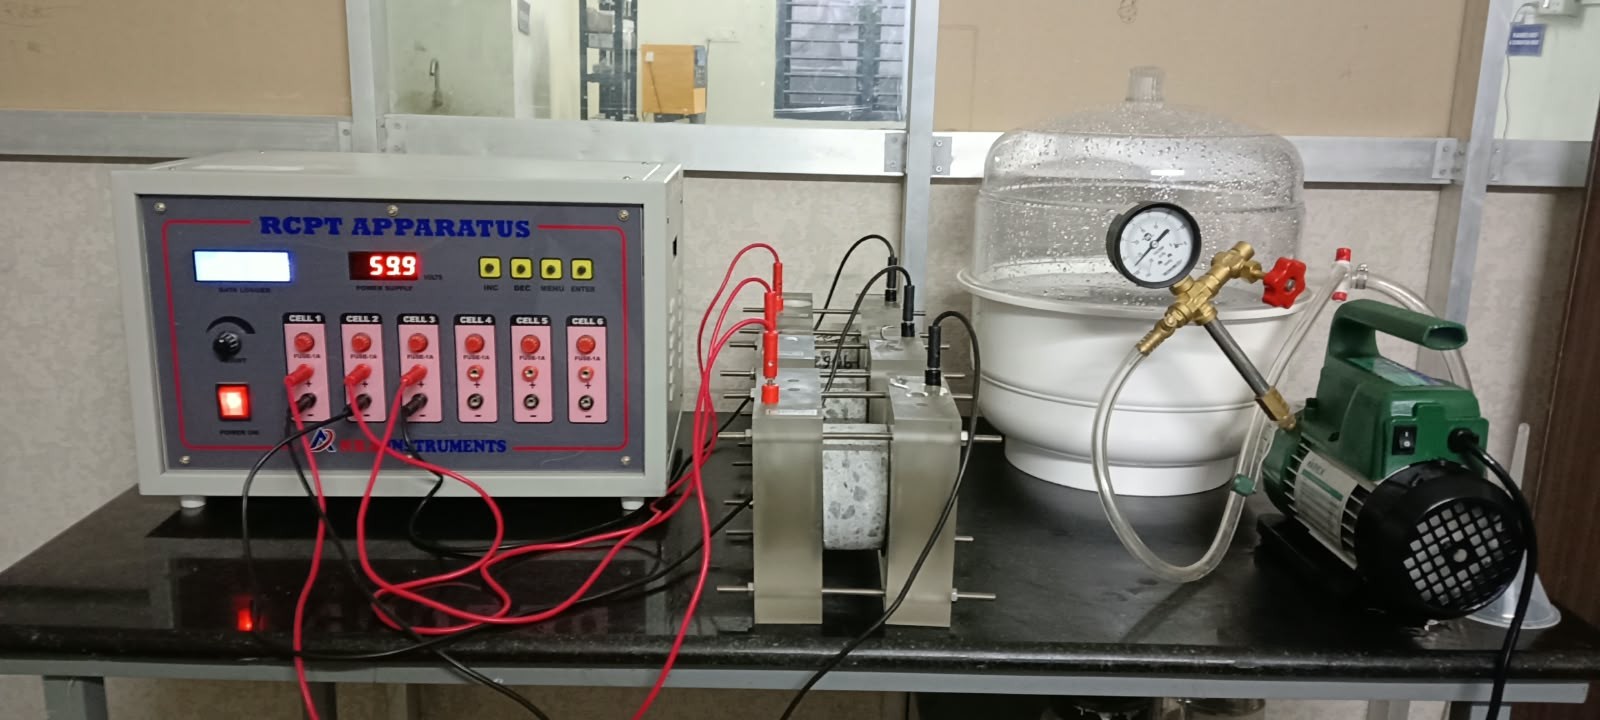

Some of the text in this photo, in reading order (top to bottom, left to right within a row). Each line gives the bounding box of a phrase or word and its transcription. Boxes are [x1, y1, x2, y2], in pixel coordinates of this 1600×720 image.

[259, 216, 531, 238] RCPT APPARATUS
[483, 284, 499, 292] INC
[571, 285, 595, 293] ENTER
[289, 314, 322, 322] CELL 1
[346, 315, 379, 323] CELL 2
[403, 315, 436, 323] CELL 3
[460, 316, 492, 324] CELL 4
[516, 316, 540, 324] CELL
[572, 317, 604, 325] CELL 6
[386, 439, 507, 453] NTRUMENTS
